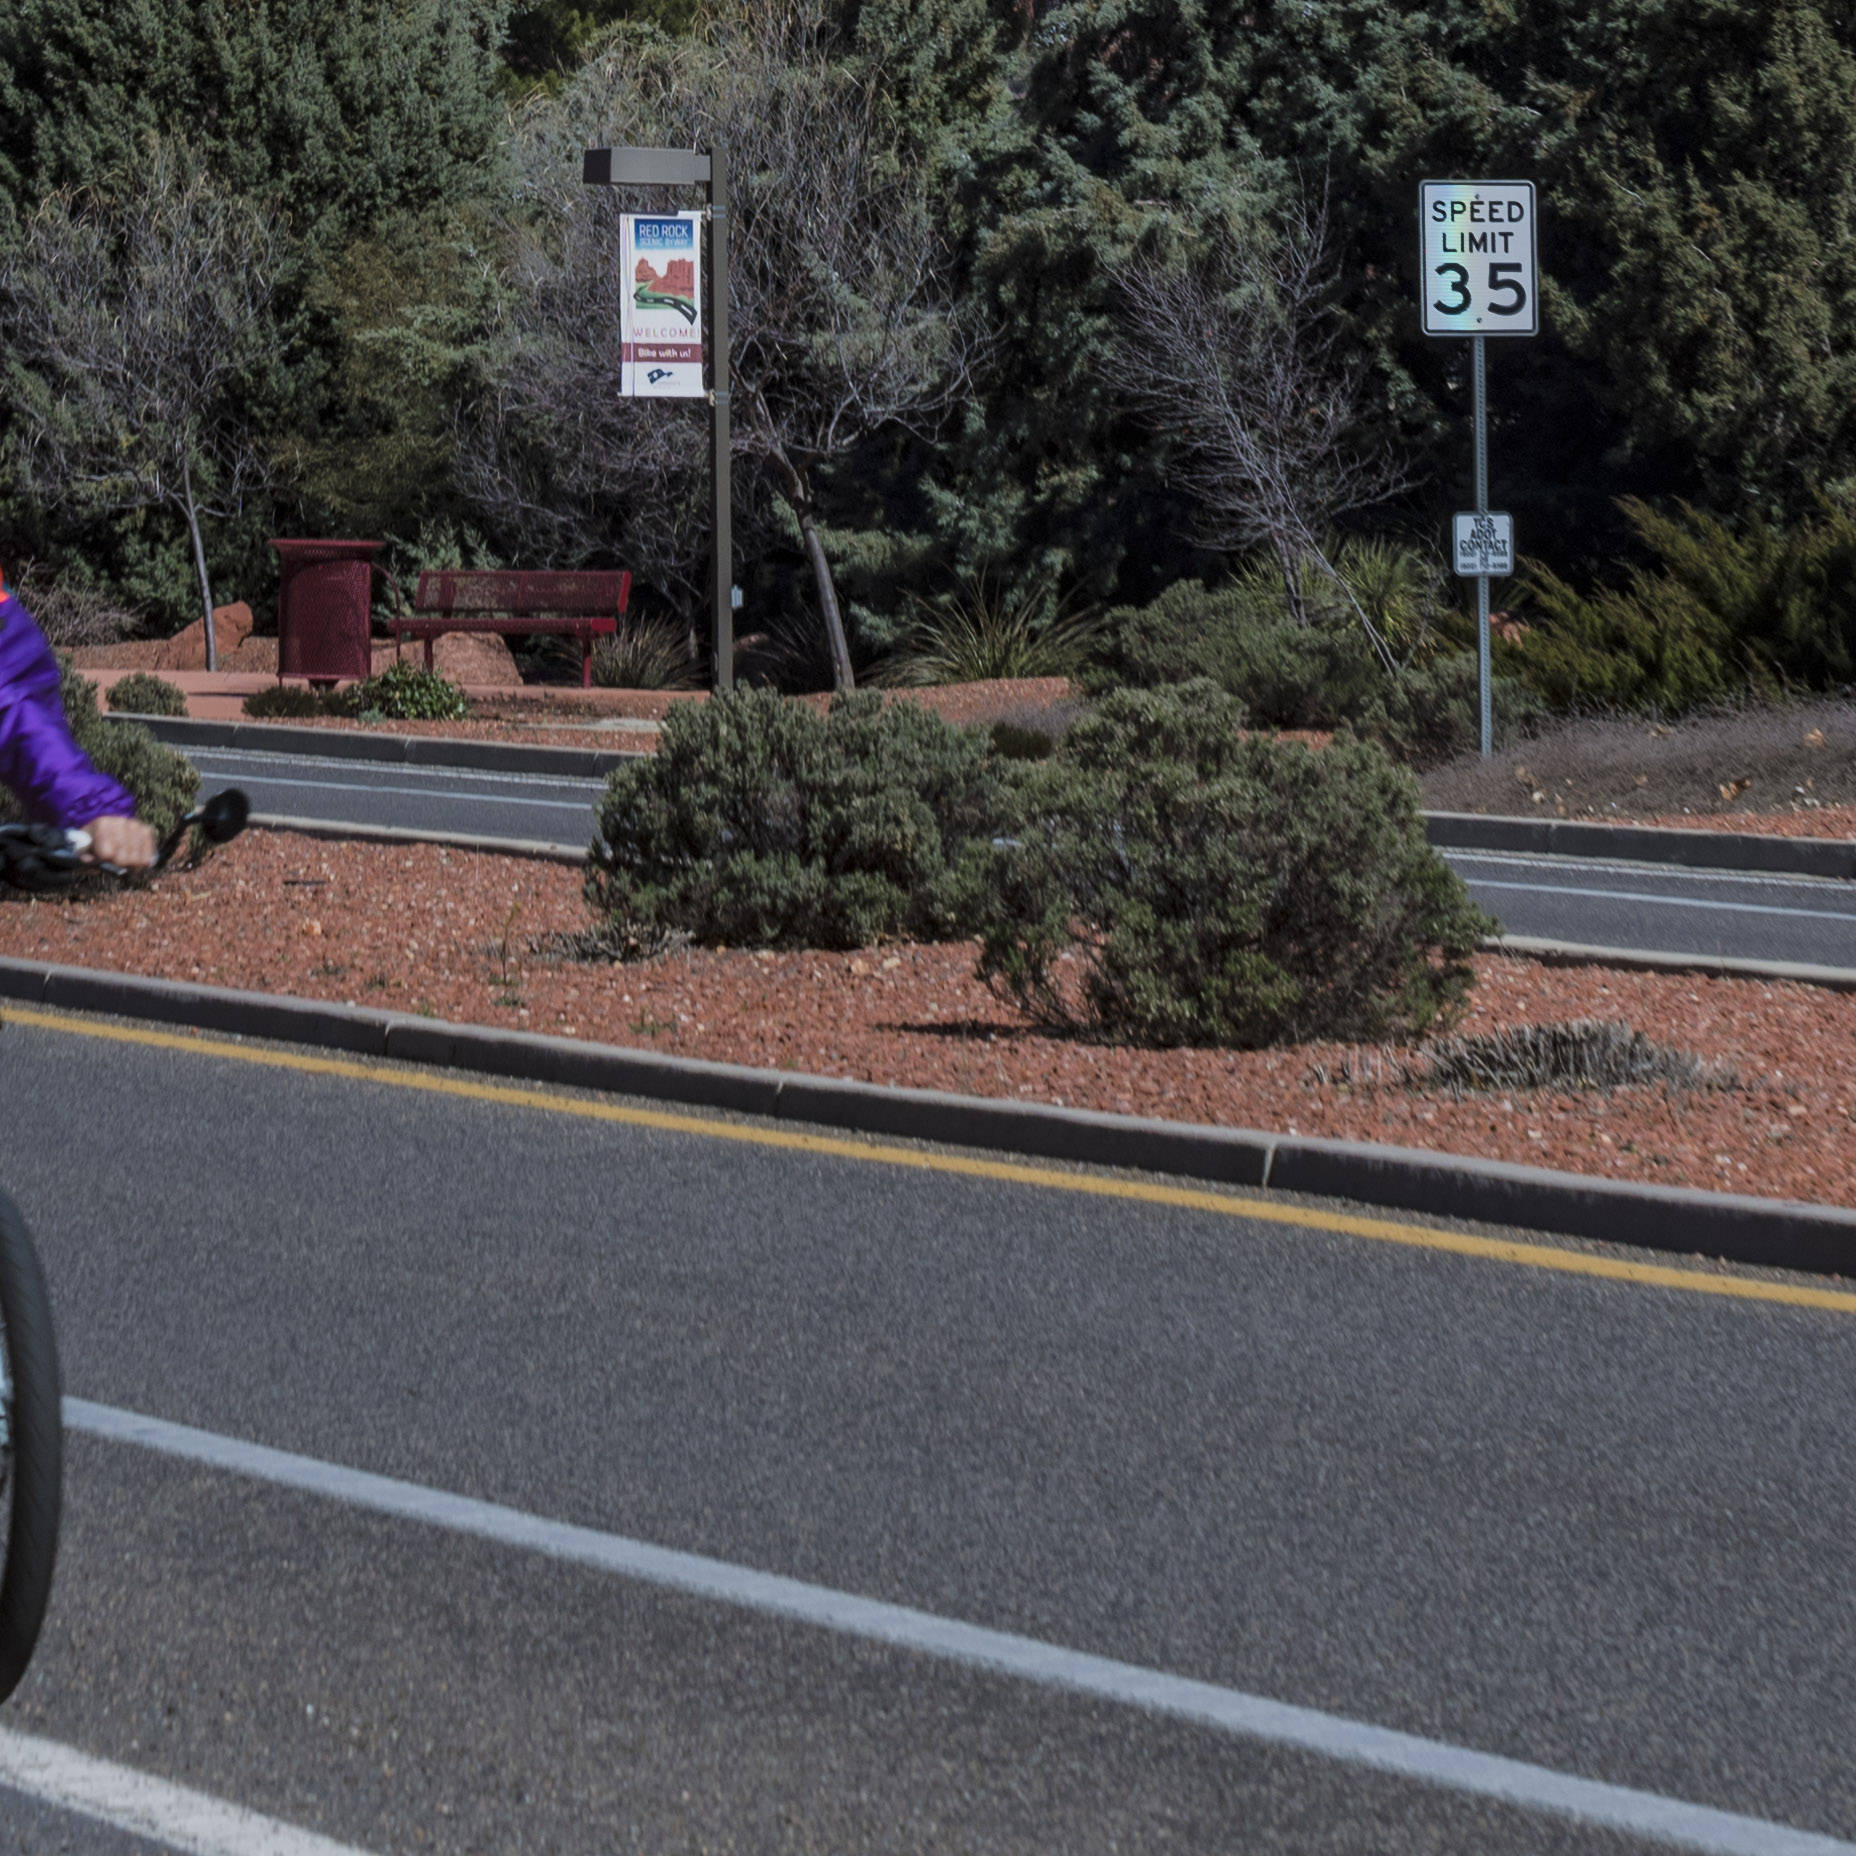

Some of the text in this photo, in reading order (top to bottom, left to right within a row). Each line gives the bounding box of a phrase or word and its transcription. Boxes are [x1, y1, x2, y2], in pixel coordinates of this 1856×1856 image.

[1432, 200, 1524, 222] SPEED
[639, 224, 689, 238] RED ROCK
[1442, 232, 1514, 253] LIMIT
[1433, 262, 1527, 316] 35
[659, 348, 678, 358] with
[1460, 539, 1508, 551] CONTACT
